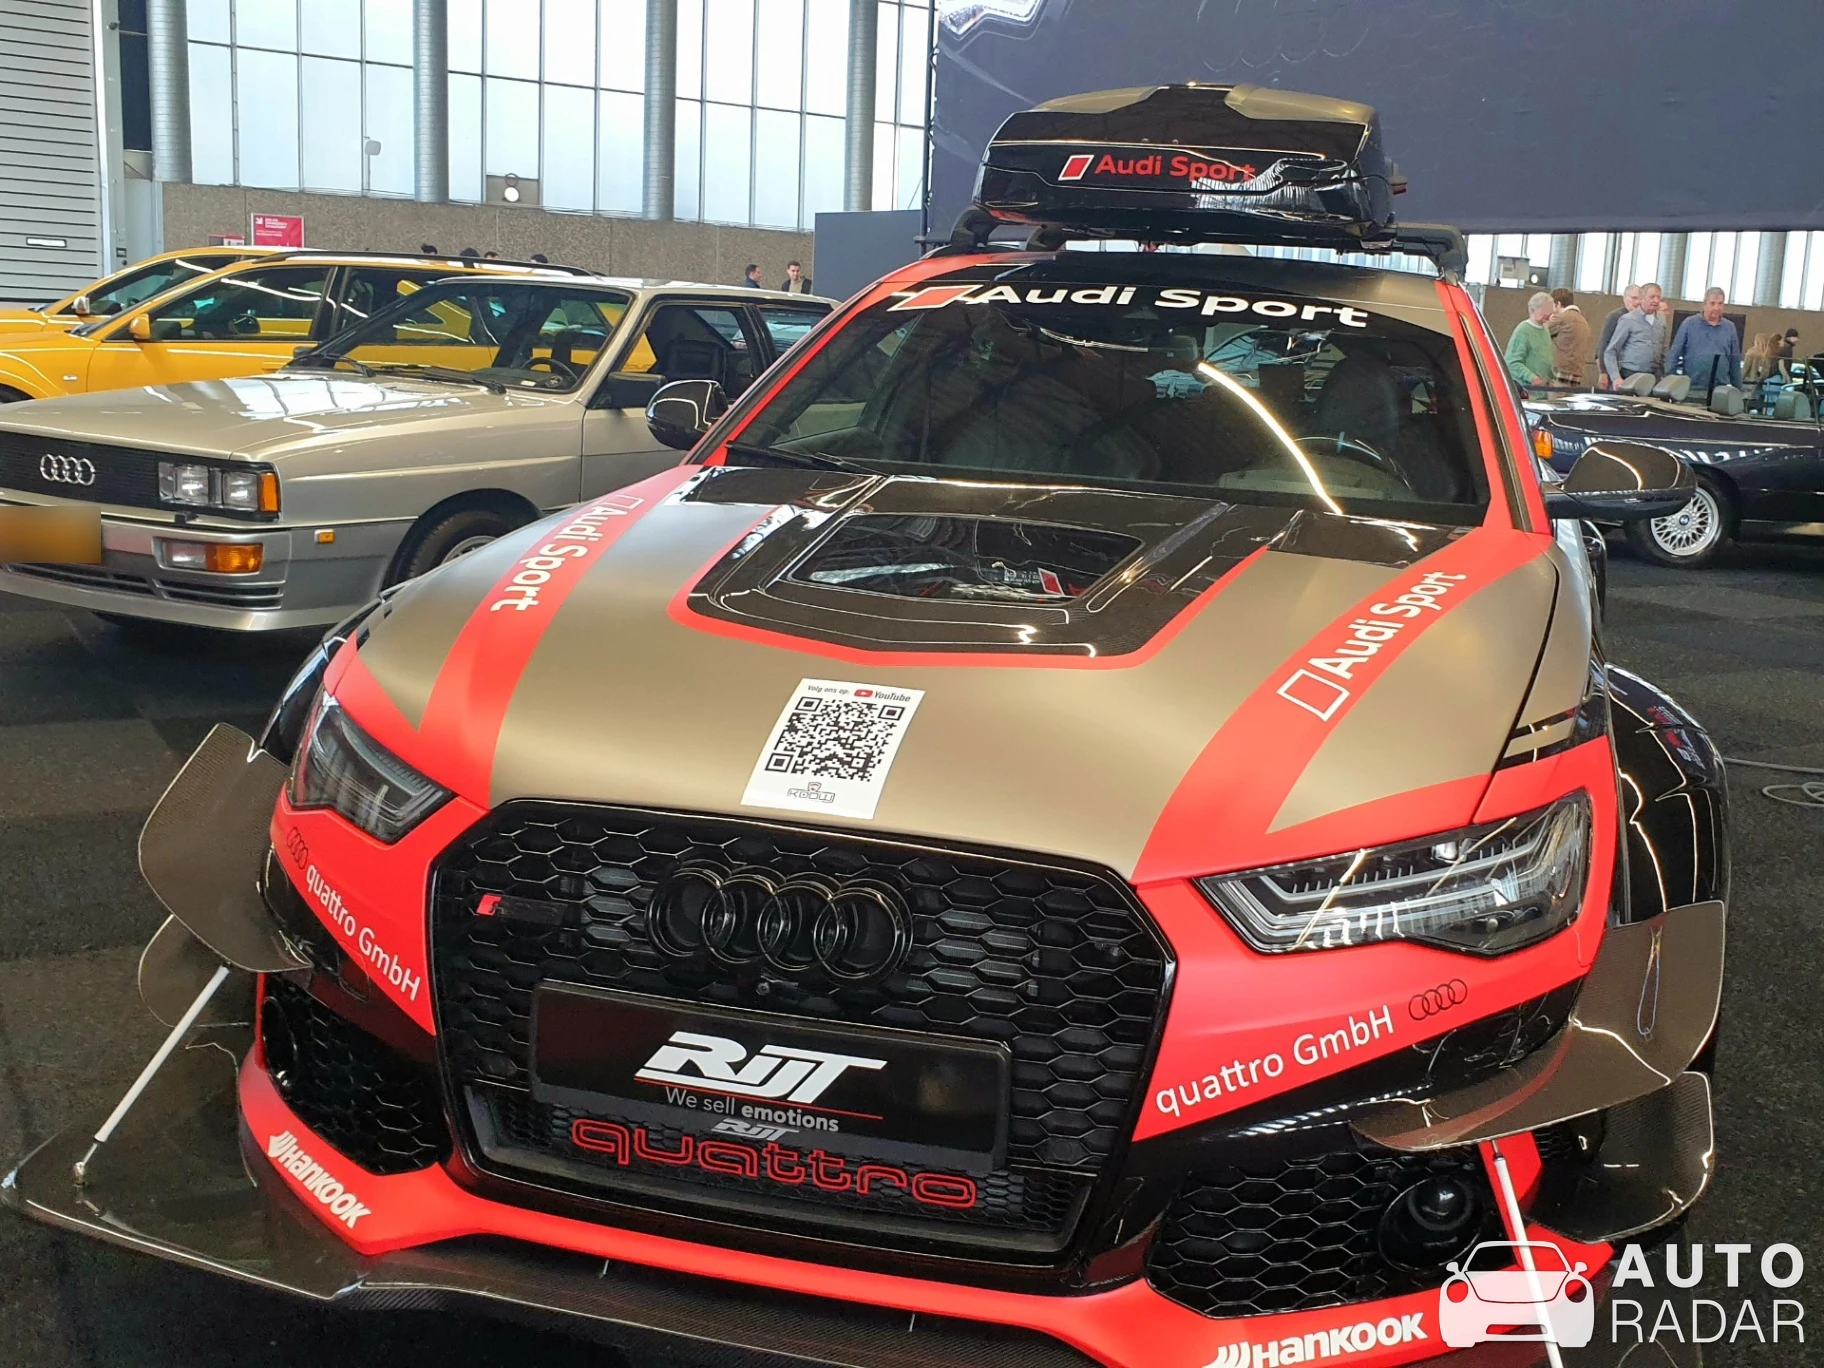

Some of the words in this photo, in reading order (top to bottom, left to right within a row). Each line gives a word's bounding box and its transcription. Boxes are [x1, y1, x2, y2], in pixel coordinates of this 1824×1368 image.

[1095, 154, 1162, 176] Audi
[1169, 156, 1256, 182] Sport
[966, 285, 1137, 305] Audi
[1154, 289, 1368, 328] Sport
[553, 506, 628, 542] Audi
[490, 543, 589, 612] Sport
[1308, 618, 1405, 680] Audi
[1370, 571, 1468, 618] Sport
[807, 685, 823, 694] Volg
[874, 691, 911, 702] YouTube
[306, 864, 356, 937] quattro
[359, 927, 421, 1001] GmbH
[1156, 1053, 1284, 1117] quattro
[1293, 1004, 1394, 1066] GmbH
[665, 1086, 698, 1108] We
[703, 1096, 735, 1116] sell
[741, 1104, 840, 1132] emotions
[571, 1119, 977, 1208] quattro
